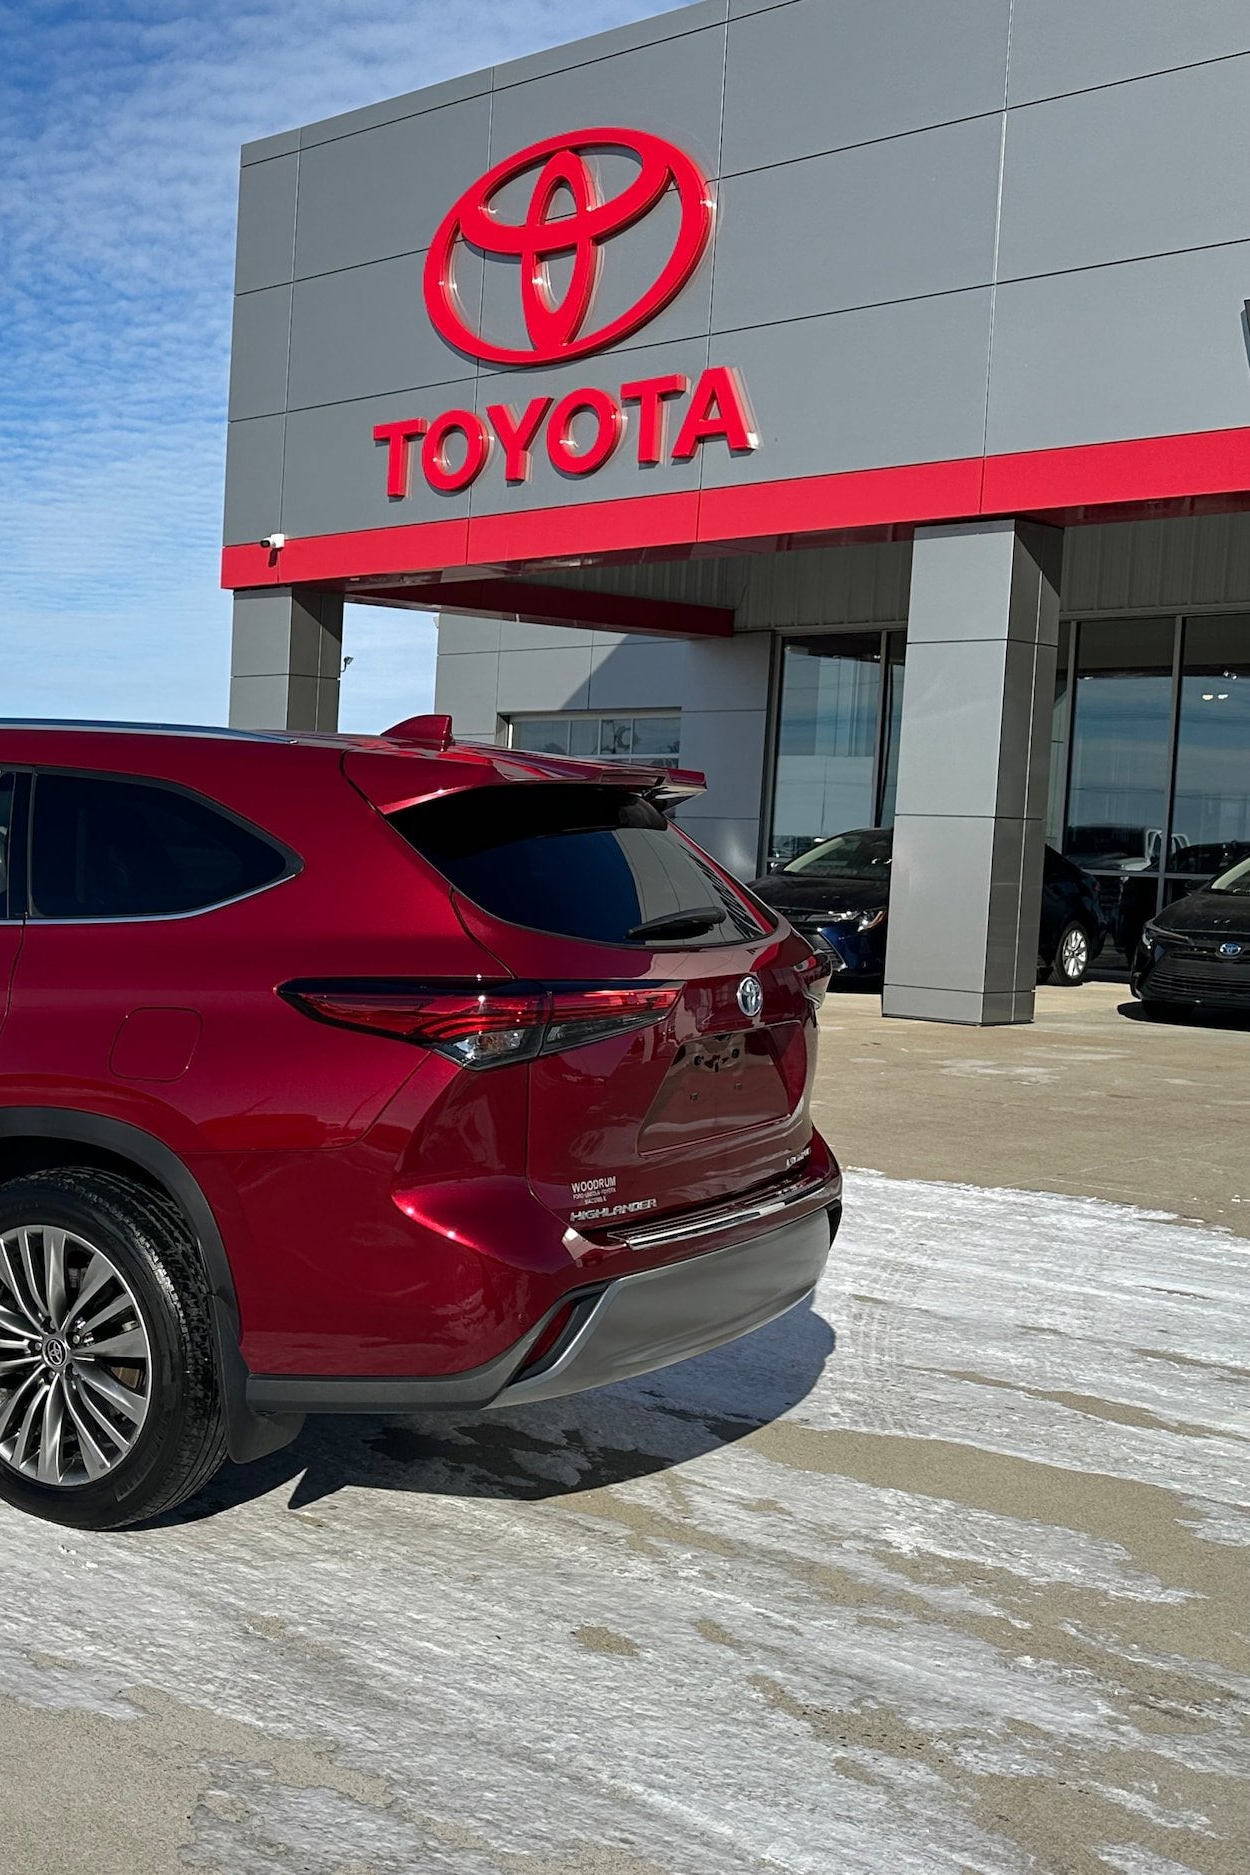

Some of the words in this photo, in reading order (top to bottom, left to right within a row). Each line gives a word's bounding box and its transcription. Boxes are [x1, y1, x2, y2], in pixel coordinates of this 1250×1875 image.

[373, 366, 758, 499] TOYOTA
[571, 1176, 616, 1193] WOODRUM
[570, 1198, 657, 1222] HIGHLANDER
